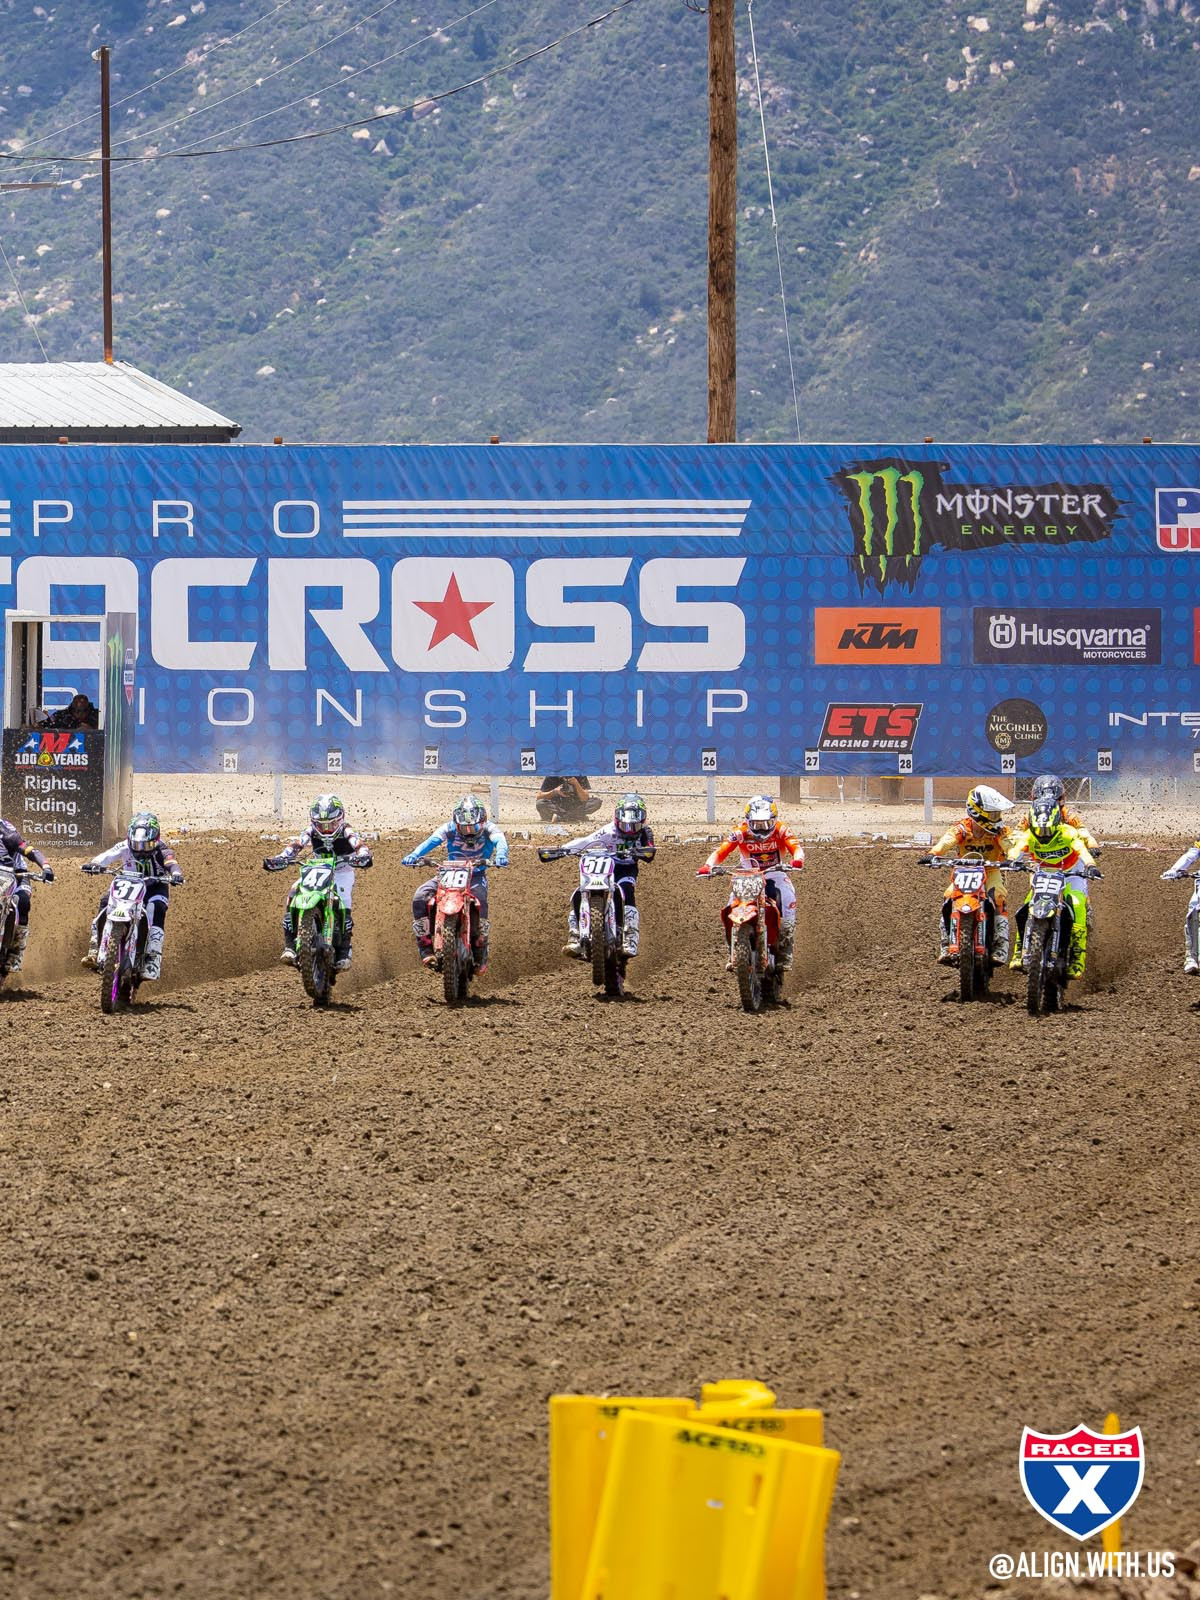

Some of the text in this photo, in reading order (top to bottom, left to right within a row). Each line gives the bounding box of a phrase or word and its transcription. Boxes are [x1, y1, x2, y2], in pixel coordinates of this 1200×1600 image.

[935, 489, 1107, 519] MONSTER
[33, 499, 320, 538] PRO
[961, 525, 1079, 535] ENERGY
[837, 622, 919, 649] KTM
[1083, 651, 1146, 659] MOTORCYCLES
[827, 708, 917, 736] ETS
[1109, 712, 1200, 726] INTE
[17, 732, 85, 753] AMA
[823, 740, 908, 748] RACING FUELS
[15, 753, 88, 766] 100 YEARS
[225, 758, 236, 768] 21
[329, 758, 340, 767] 22
[425, 755, 437, 765] 23
[522, 757, 534, 766] 24
[616, 759, 627, 768] 25
[704, 757, 715, 766] 26
[807, 757, 817, 766] 27
[900, 760, 911, 768] 28
[1003, 760, 1014, 768] 29
[1099, 757, 1111, 766] 30
[25, 775, 81, 793] Rights.
[24, 798, 81, 815] Riding.
[22, 820, 82, 836] Racing.
[583, 856, 612, 874] 511
[303, 868, 332, 887] 47
[440, 871, 469, 888] 48
[954, 872, 983, 889] 473
[113, 880, 144, 900] 31
